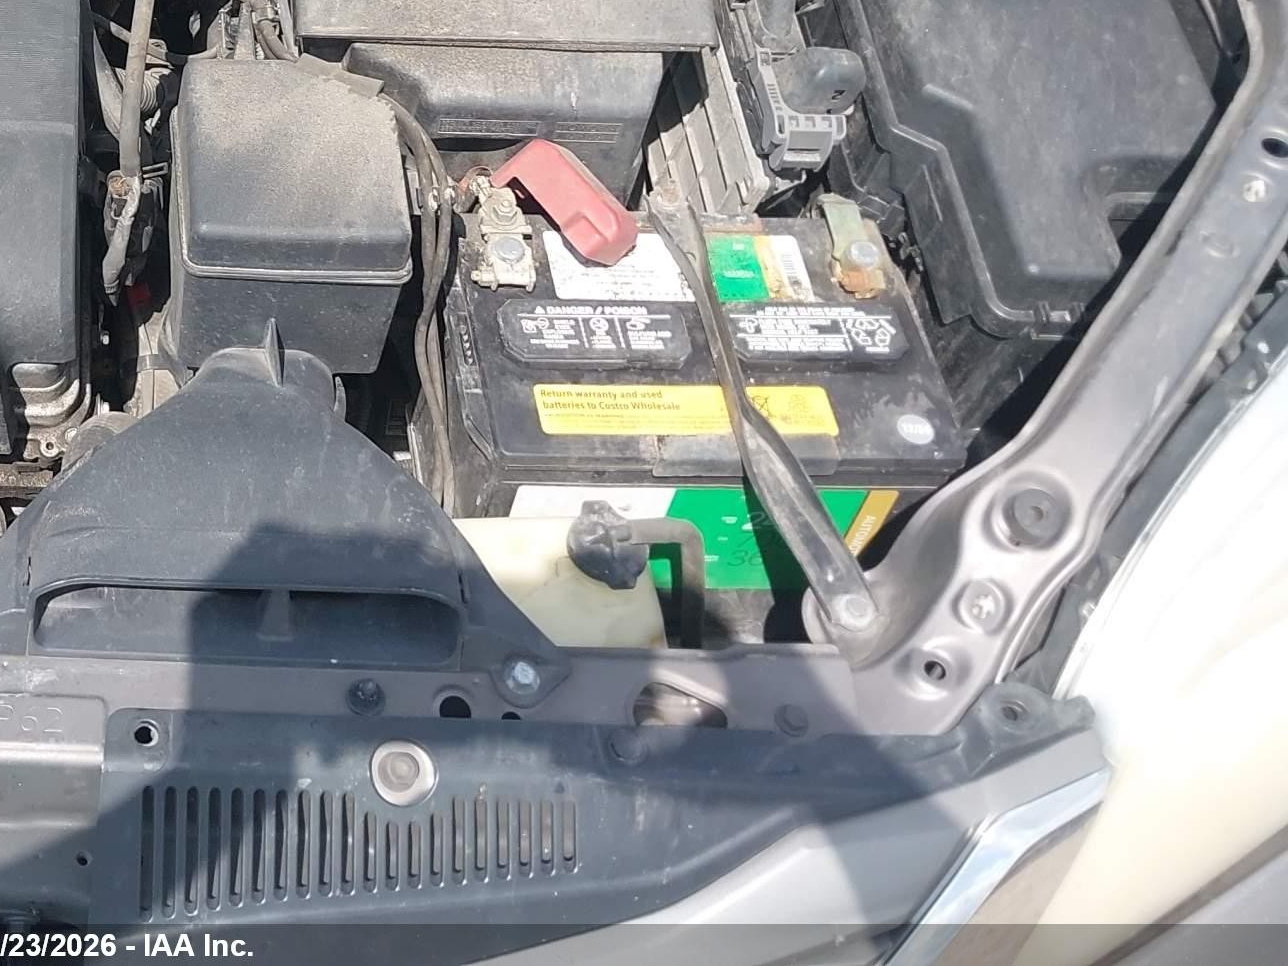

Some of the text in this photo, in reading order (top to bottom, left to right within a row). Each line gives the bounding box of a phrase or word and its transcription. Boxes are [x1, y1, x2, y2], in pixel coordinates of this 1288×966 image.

[546, 305, 594, 315] DANGER
[603, 306, 648, 315] POISON
[540, 389, 663, 400] Return warranty and used
[542, 401, 681, 411] batteries to Costco Wholesale
